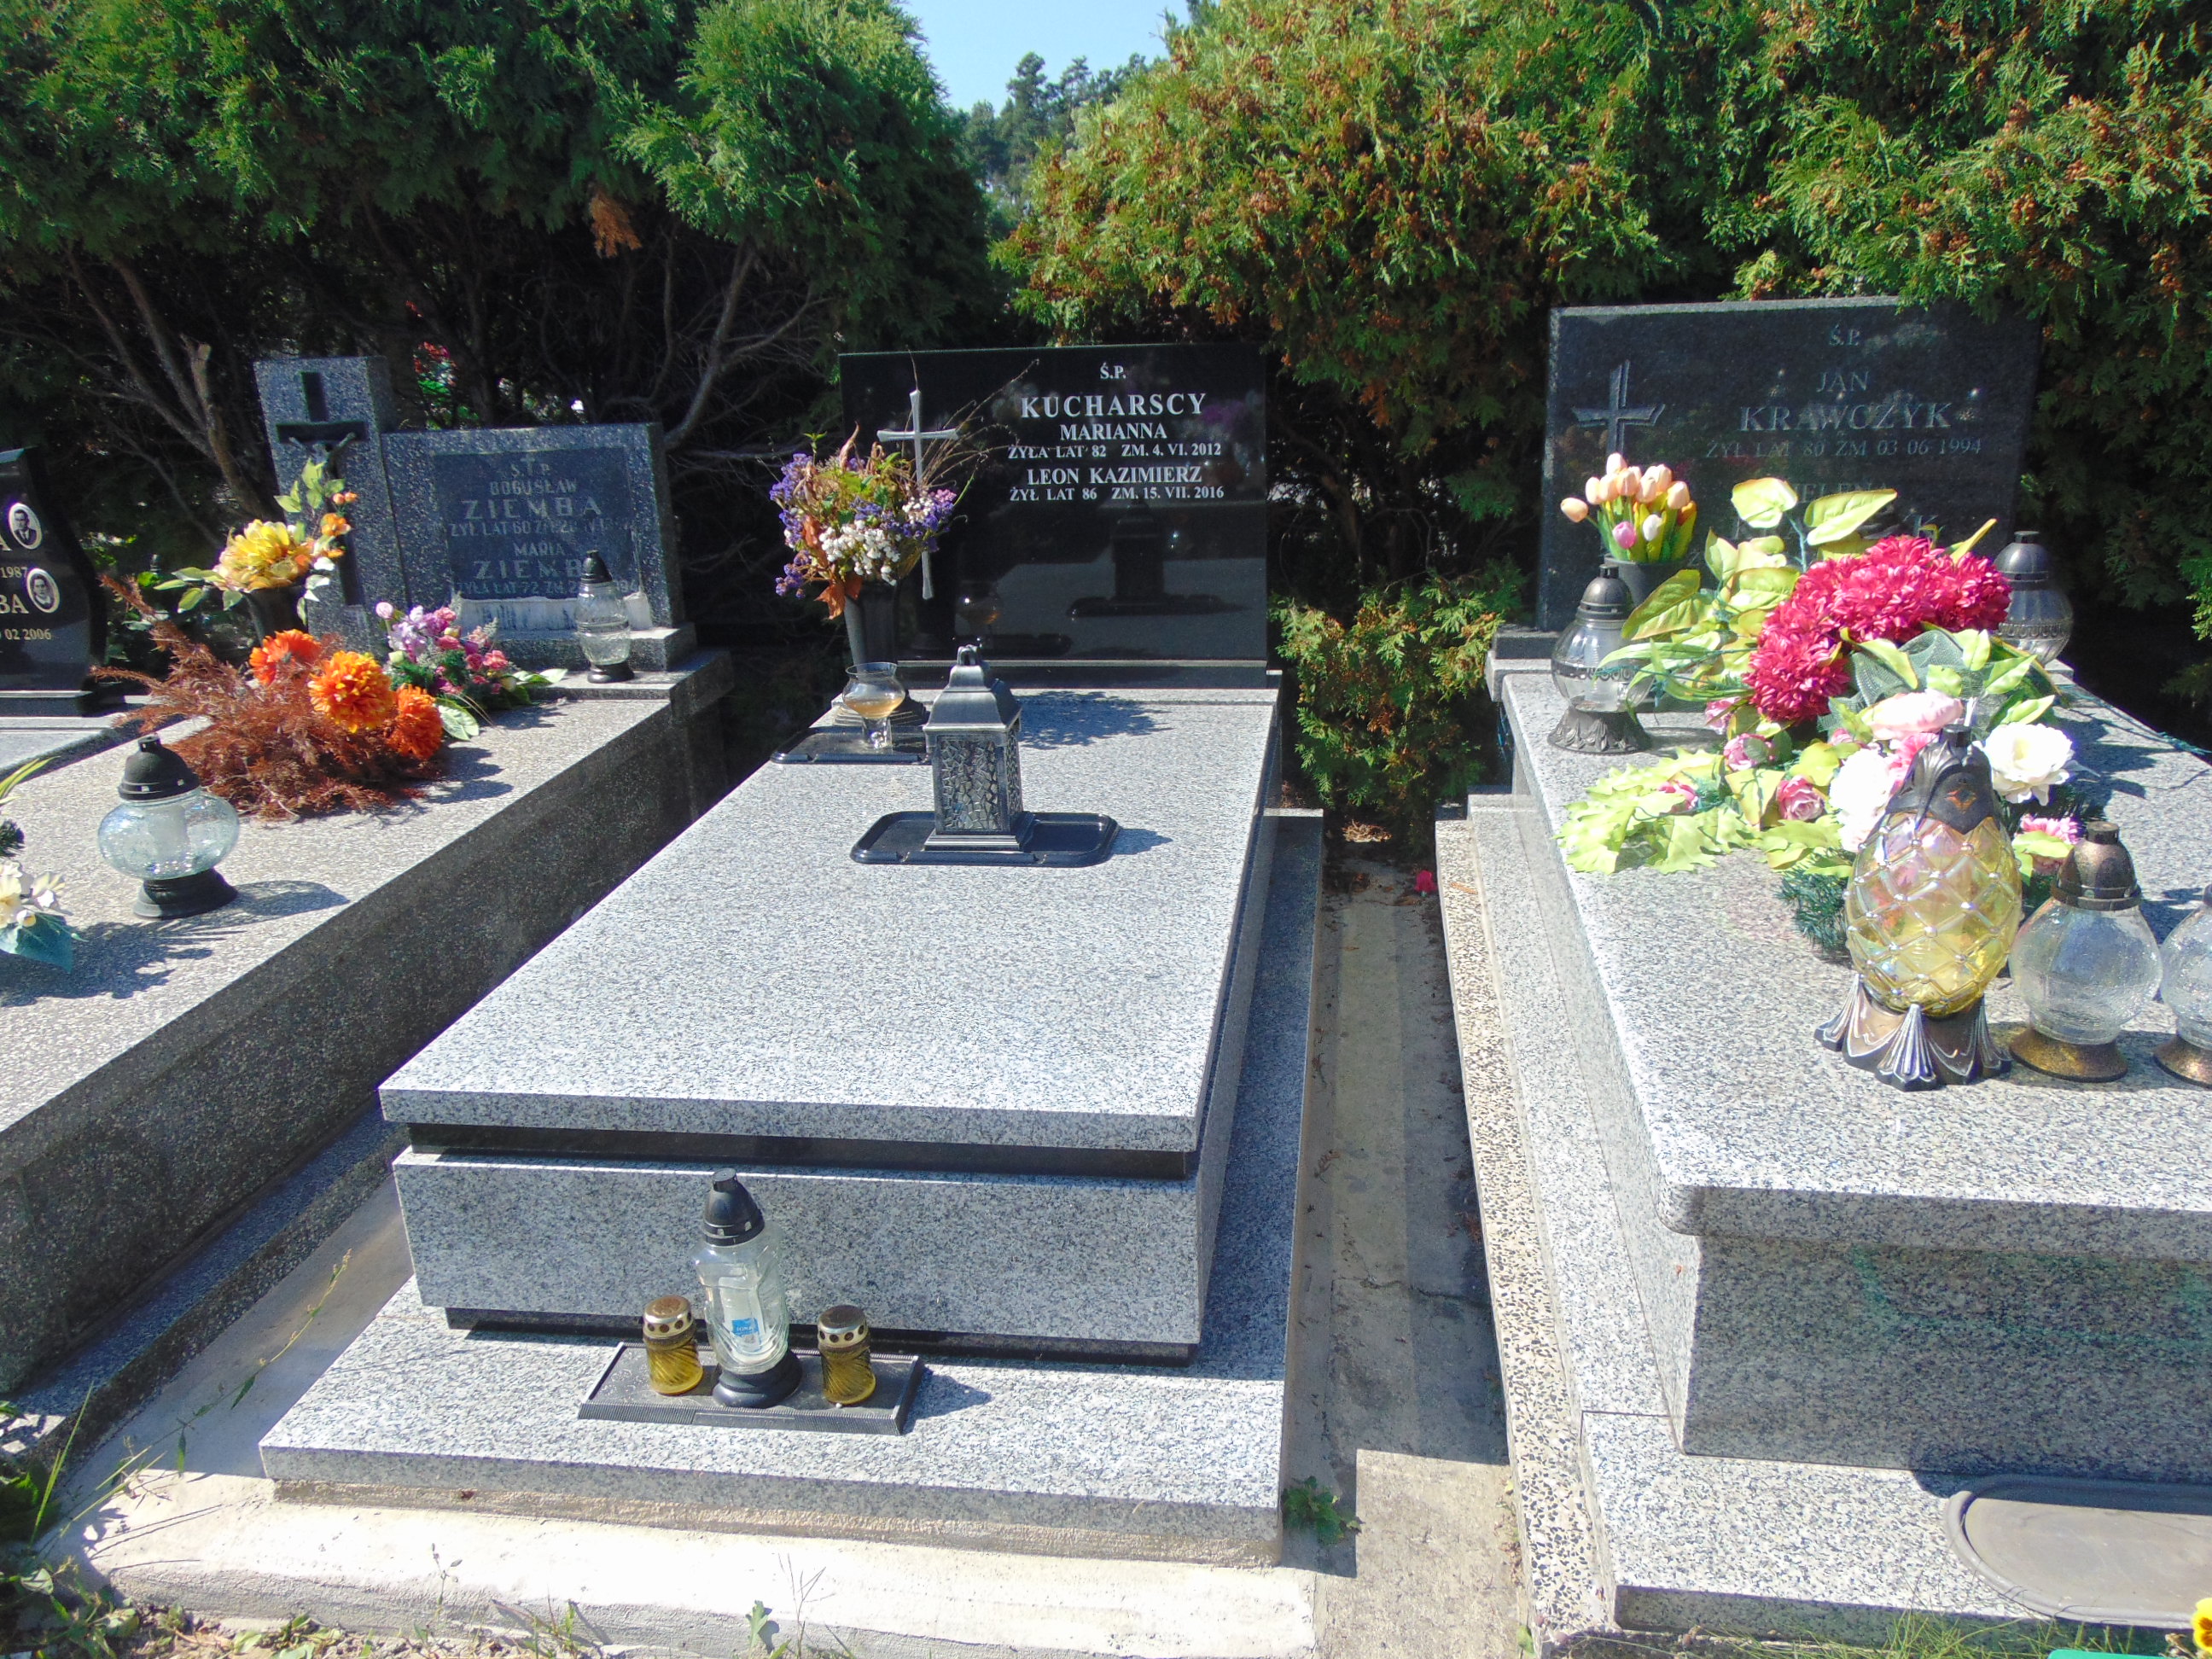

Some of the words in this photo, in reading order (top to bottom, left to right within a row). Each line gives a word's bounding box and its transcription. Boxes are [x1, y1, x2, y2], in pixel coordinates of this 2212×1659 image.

[1099, 362, 1126, 380] Ś.P.
[1816, 370, 1871, 393] JAN
[1021, 393, 1207, 418] KUCHARSCY
[1739, 402, 1953, 431] KRAWCZYK
[1060, 422, 1167, 441] MARIANNA
[1008, 444, 1049, 459] ŻYŁA
[1057, 445, 1085, 458] LAT
[1091, 445, 1107, 457] 82
[1121, 444, 1149, 457] ZM.
[1152, 444, 1164, 457] 4.
[1167, 443, 1188, 456] VI.
[1191, 442, 1221, 456] 2012
[1802, 439, 1825, 457] 80
[1877, 439, 1898, 456] 03
[1907, 439, 1929, 456] 06
[1938, 438, 1982, 456] 1994
[1027, 468, 1080, 485] LEON
[1089, 466, 1202, 485] KAZIMIERZ
[1010, 486, 1039, 501] ŻYŁ
[1046, 487, 1075, 500] LAT
[1082, 487, 1097, 500] 86
[1111, 486, 1139, 500] ZM.
[1144, 486, 1161, 499] 15.
[1164, 486, 1190, 498] VII.
[1194, 486, 1225, 498] 2016
[461, 496, 602, 520] ZIEMBA
[513, 541, 565, 556] MARIA
[0, 567, 27, 578] 1987
[473, 557, 583, 580] ZIEMB
[4, 629, 20, 640] 02
[22, 629, 51, 640] 2006
